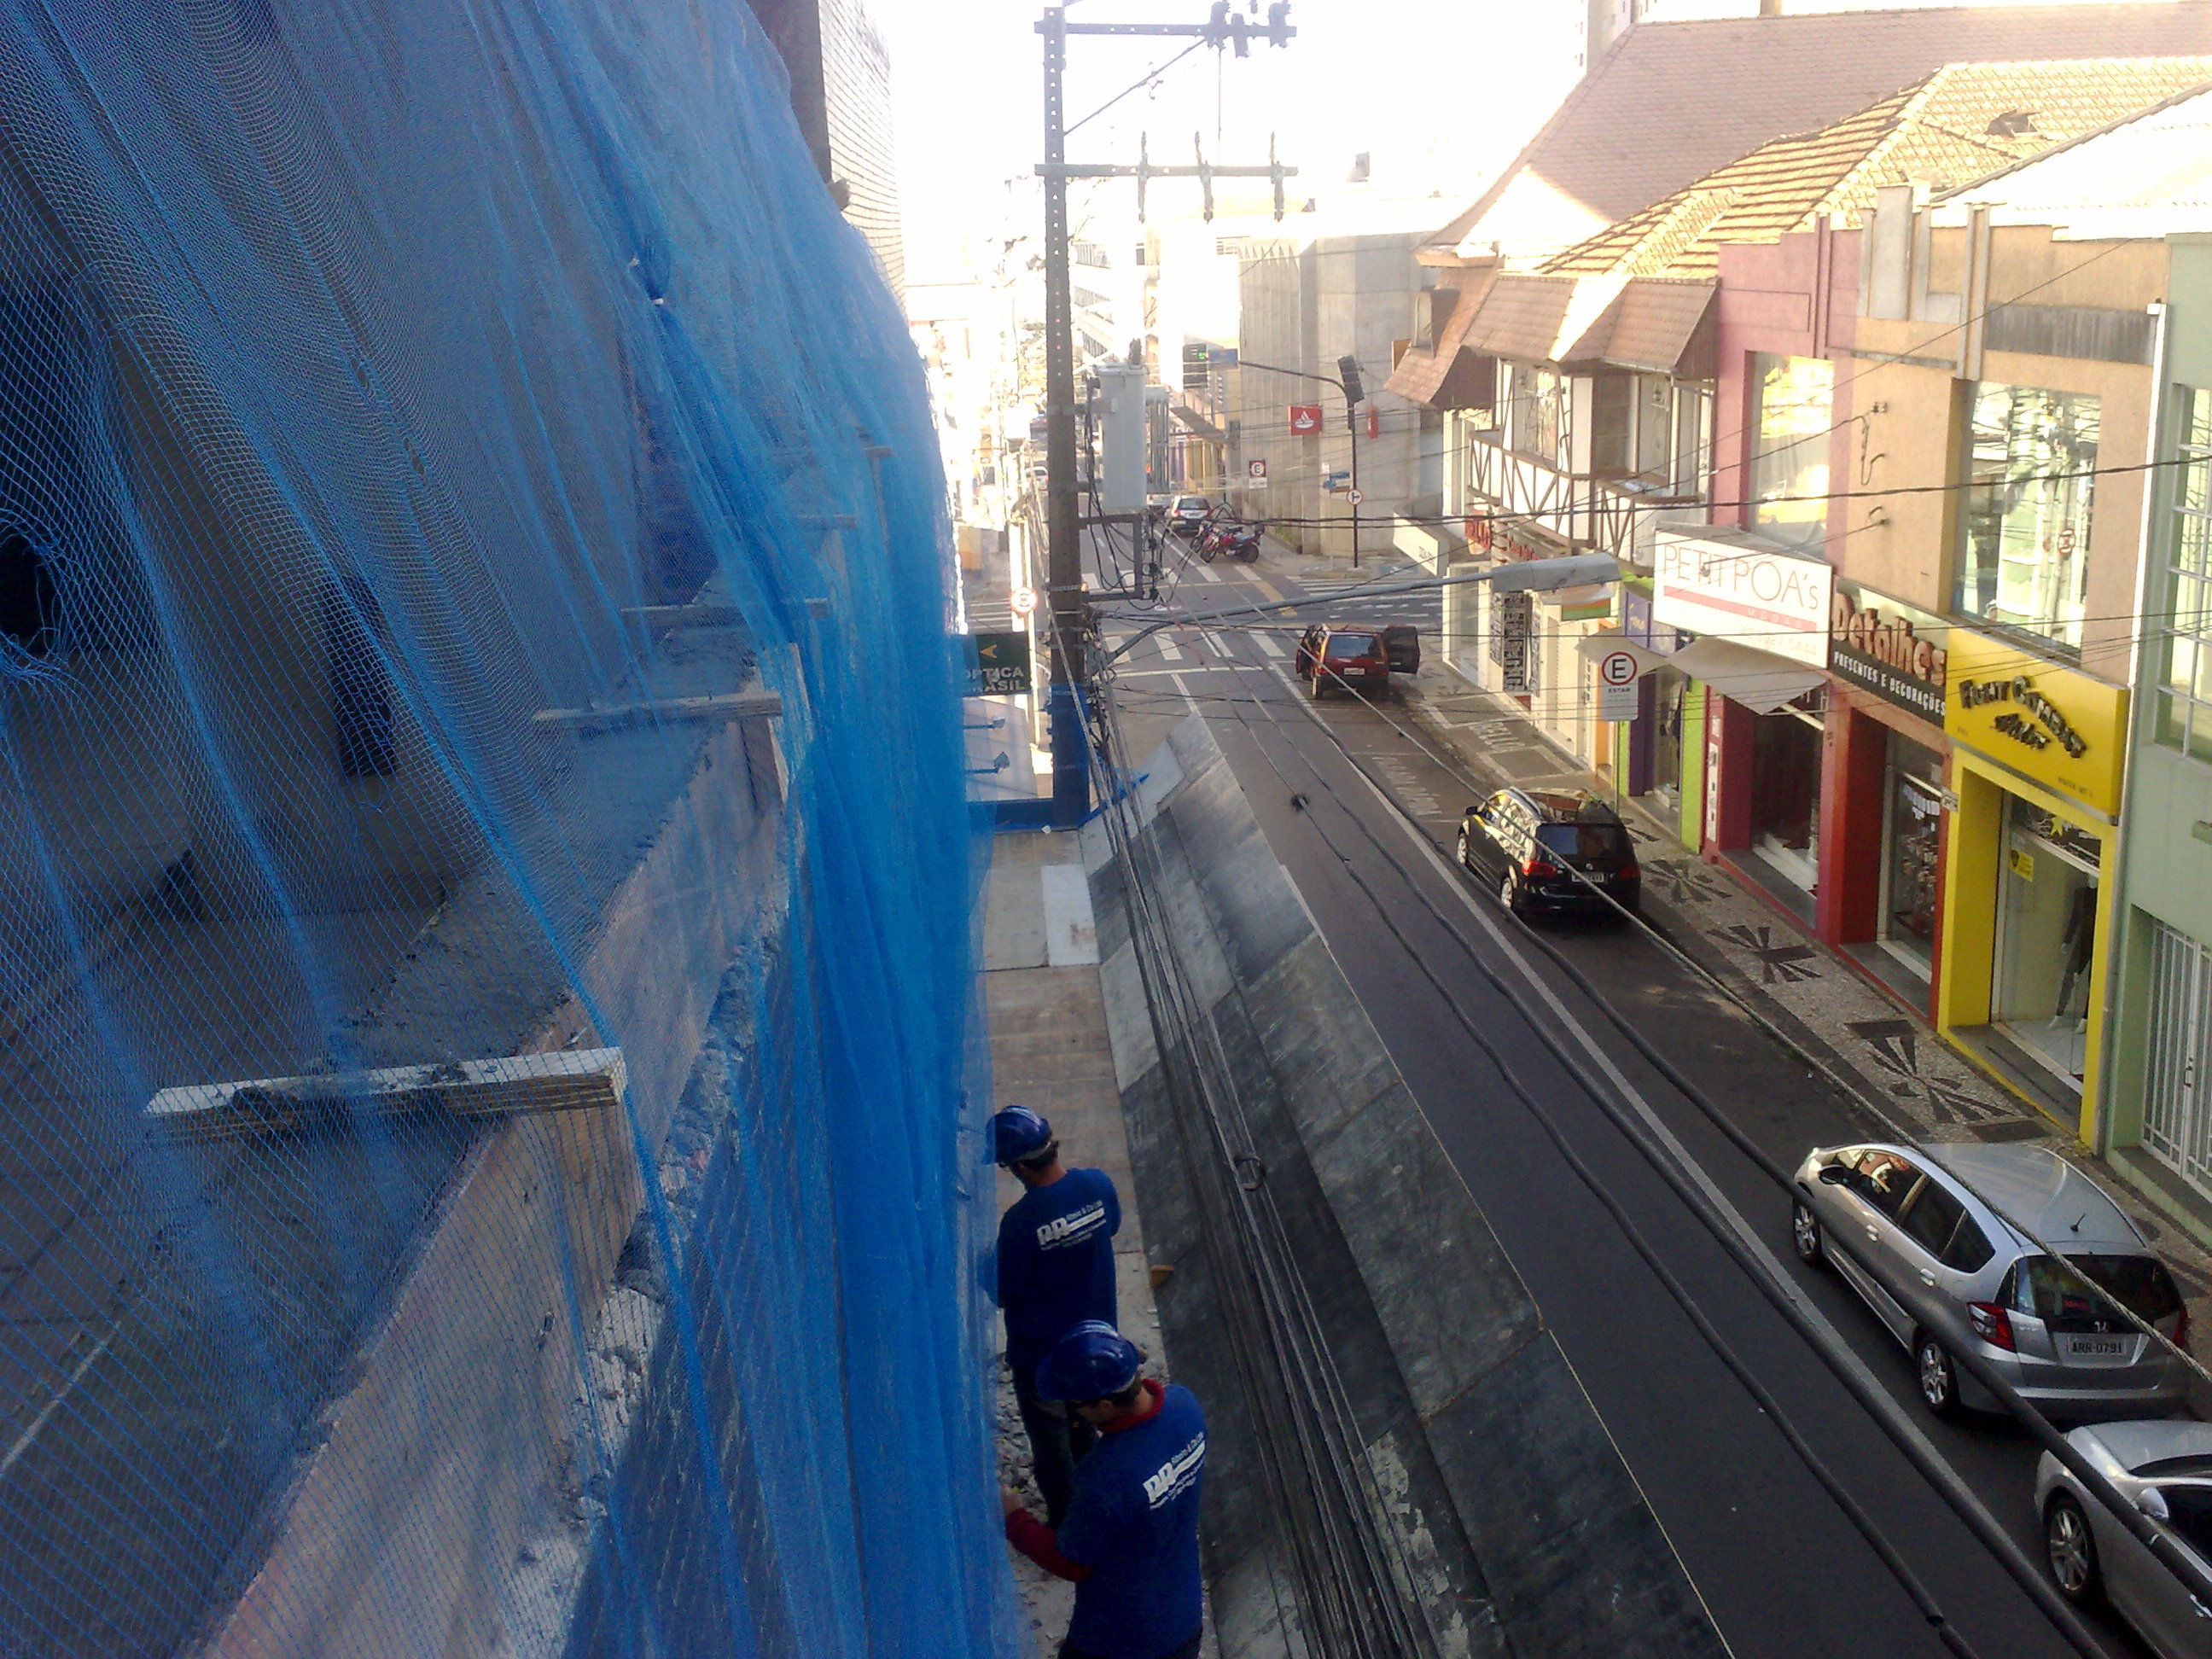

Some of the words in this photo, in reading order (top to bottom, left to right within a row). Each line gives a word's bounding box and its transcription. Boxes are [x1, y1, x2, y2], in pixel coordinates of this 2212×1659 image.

[1831, 592, 1947, 686] Detalhes
[1611, 658, 1627, 679] E
[1833, 651, 1878, 684] PRESENTES
[1880, 672, 1887, 688] E
